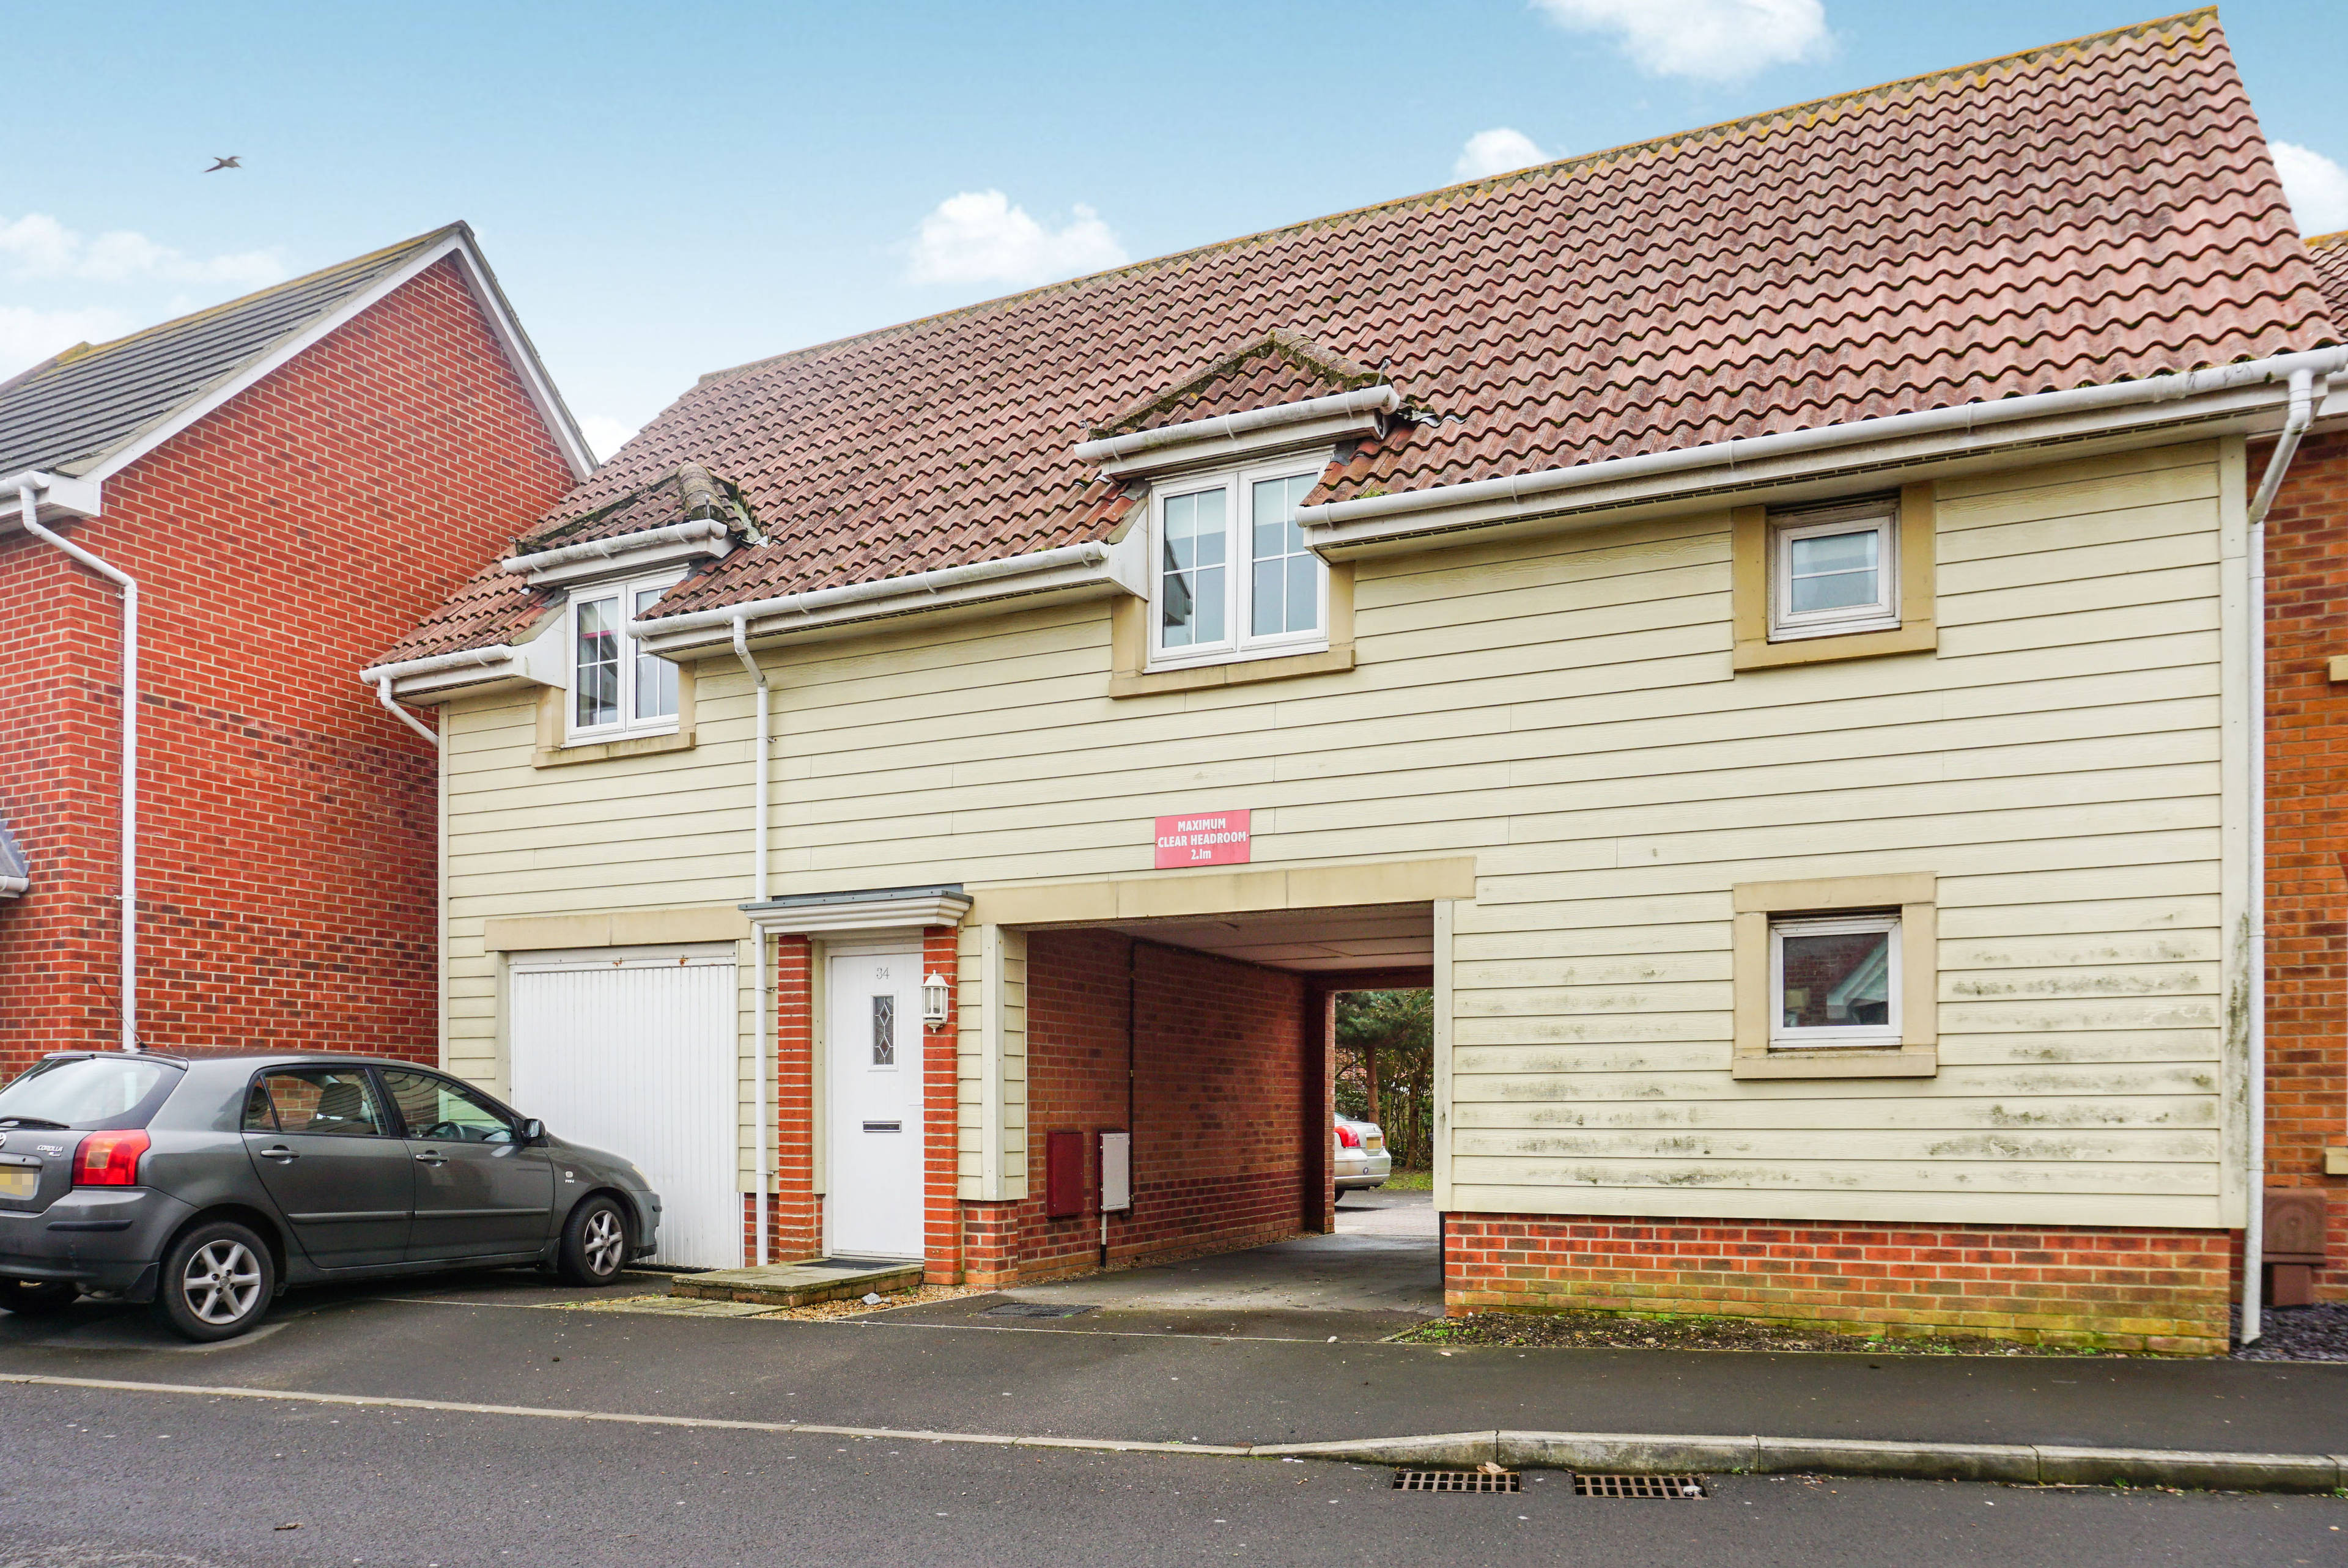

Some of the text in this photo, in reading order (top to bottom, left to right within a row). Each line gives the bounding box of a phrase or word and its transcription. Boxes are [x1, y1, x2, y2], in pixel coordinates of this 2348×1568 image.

[1178, 818, 1226, 832] MAXIMUM
[1157, 831, 1246, 848] CLEAR HEADROOM
[876, 967, 890, 979] 34
